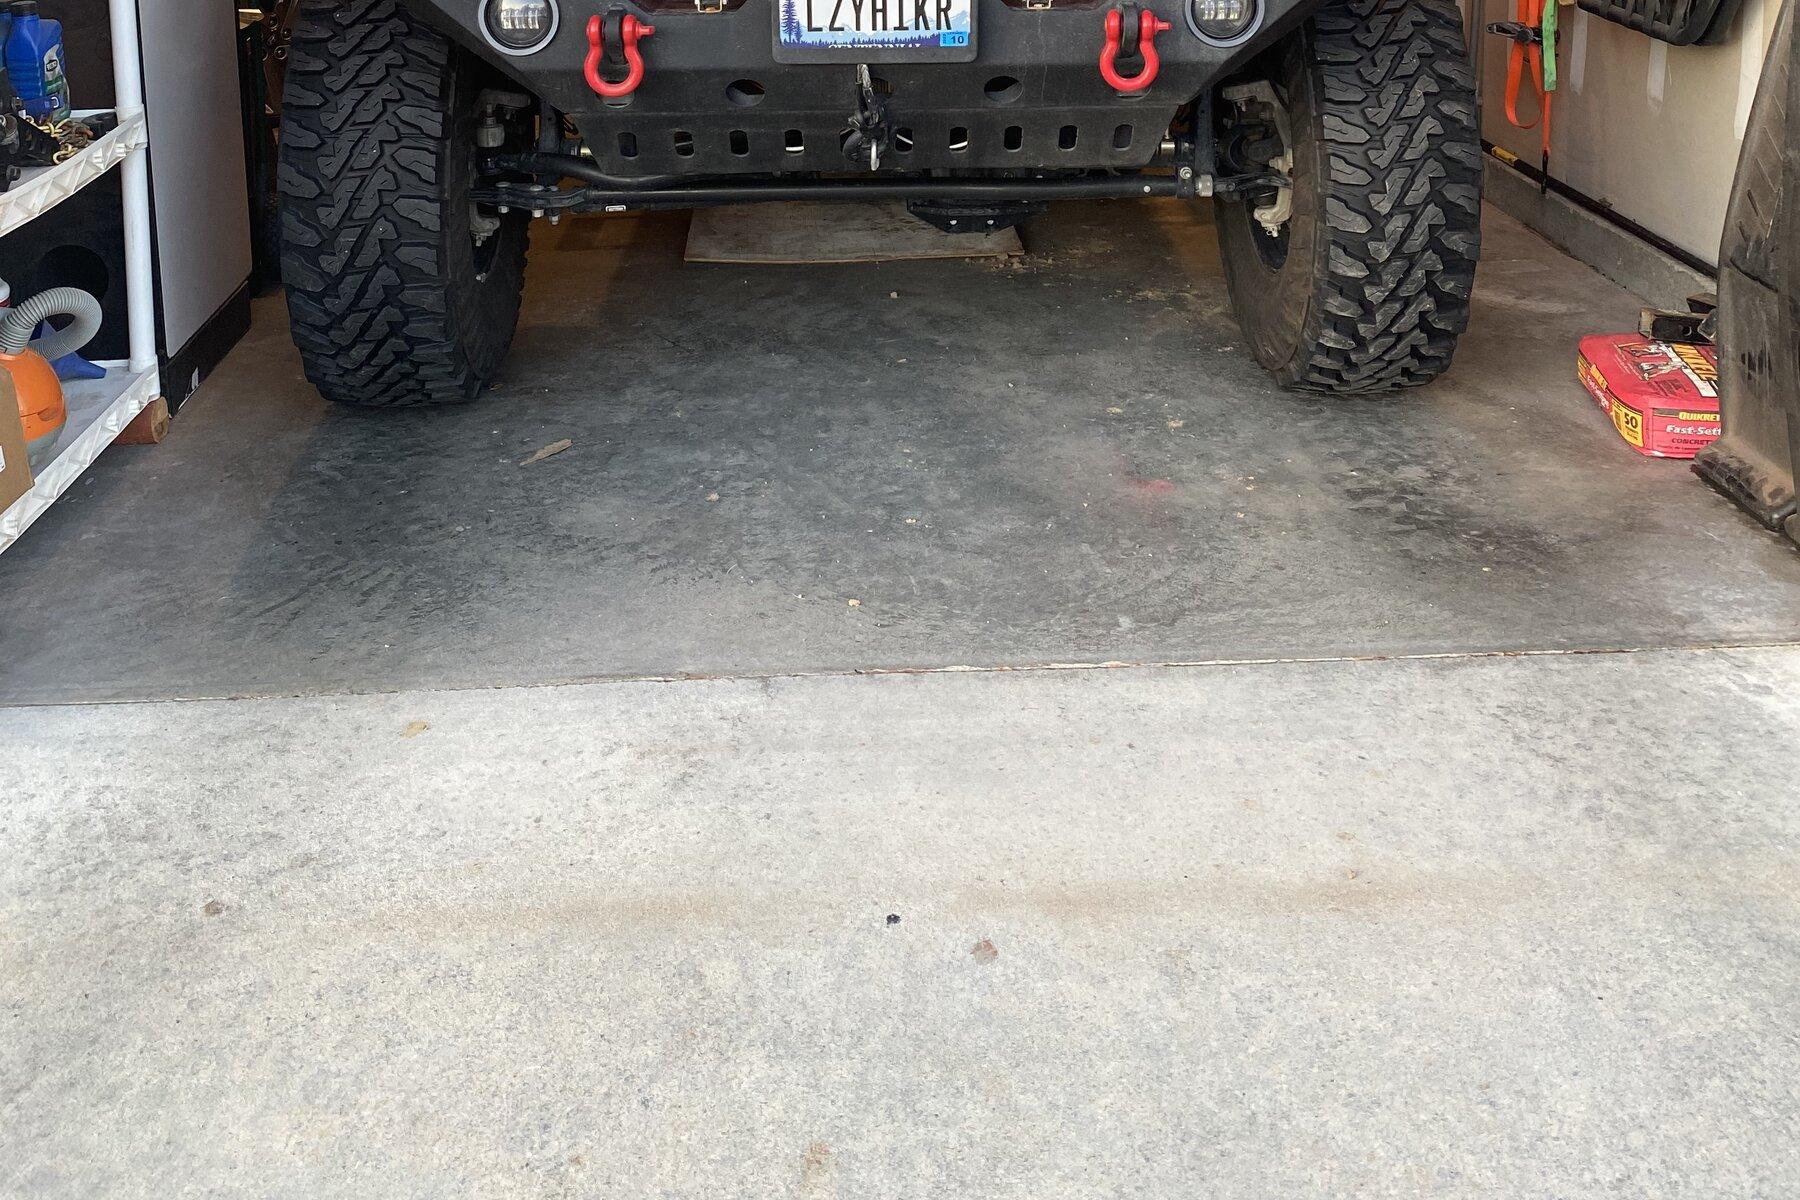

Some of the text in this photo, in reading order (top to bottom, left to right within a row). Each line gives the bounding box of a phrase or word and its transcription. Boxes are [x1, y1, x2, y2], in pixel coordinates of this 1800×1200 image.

[950, 35, 965, 44] 10
[1624, 412, 1639, 429] 50
[1678, 411, 1720, 421] QUIKRET
[1666, 424, 1721, 436] Fast-Sett
